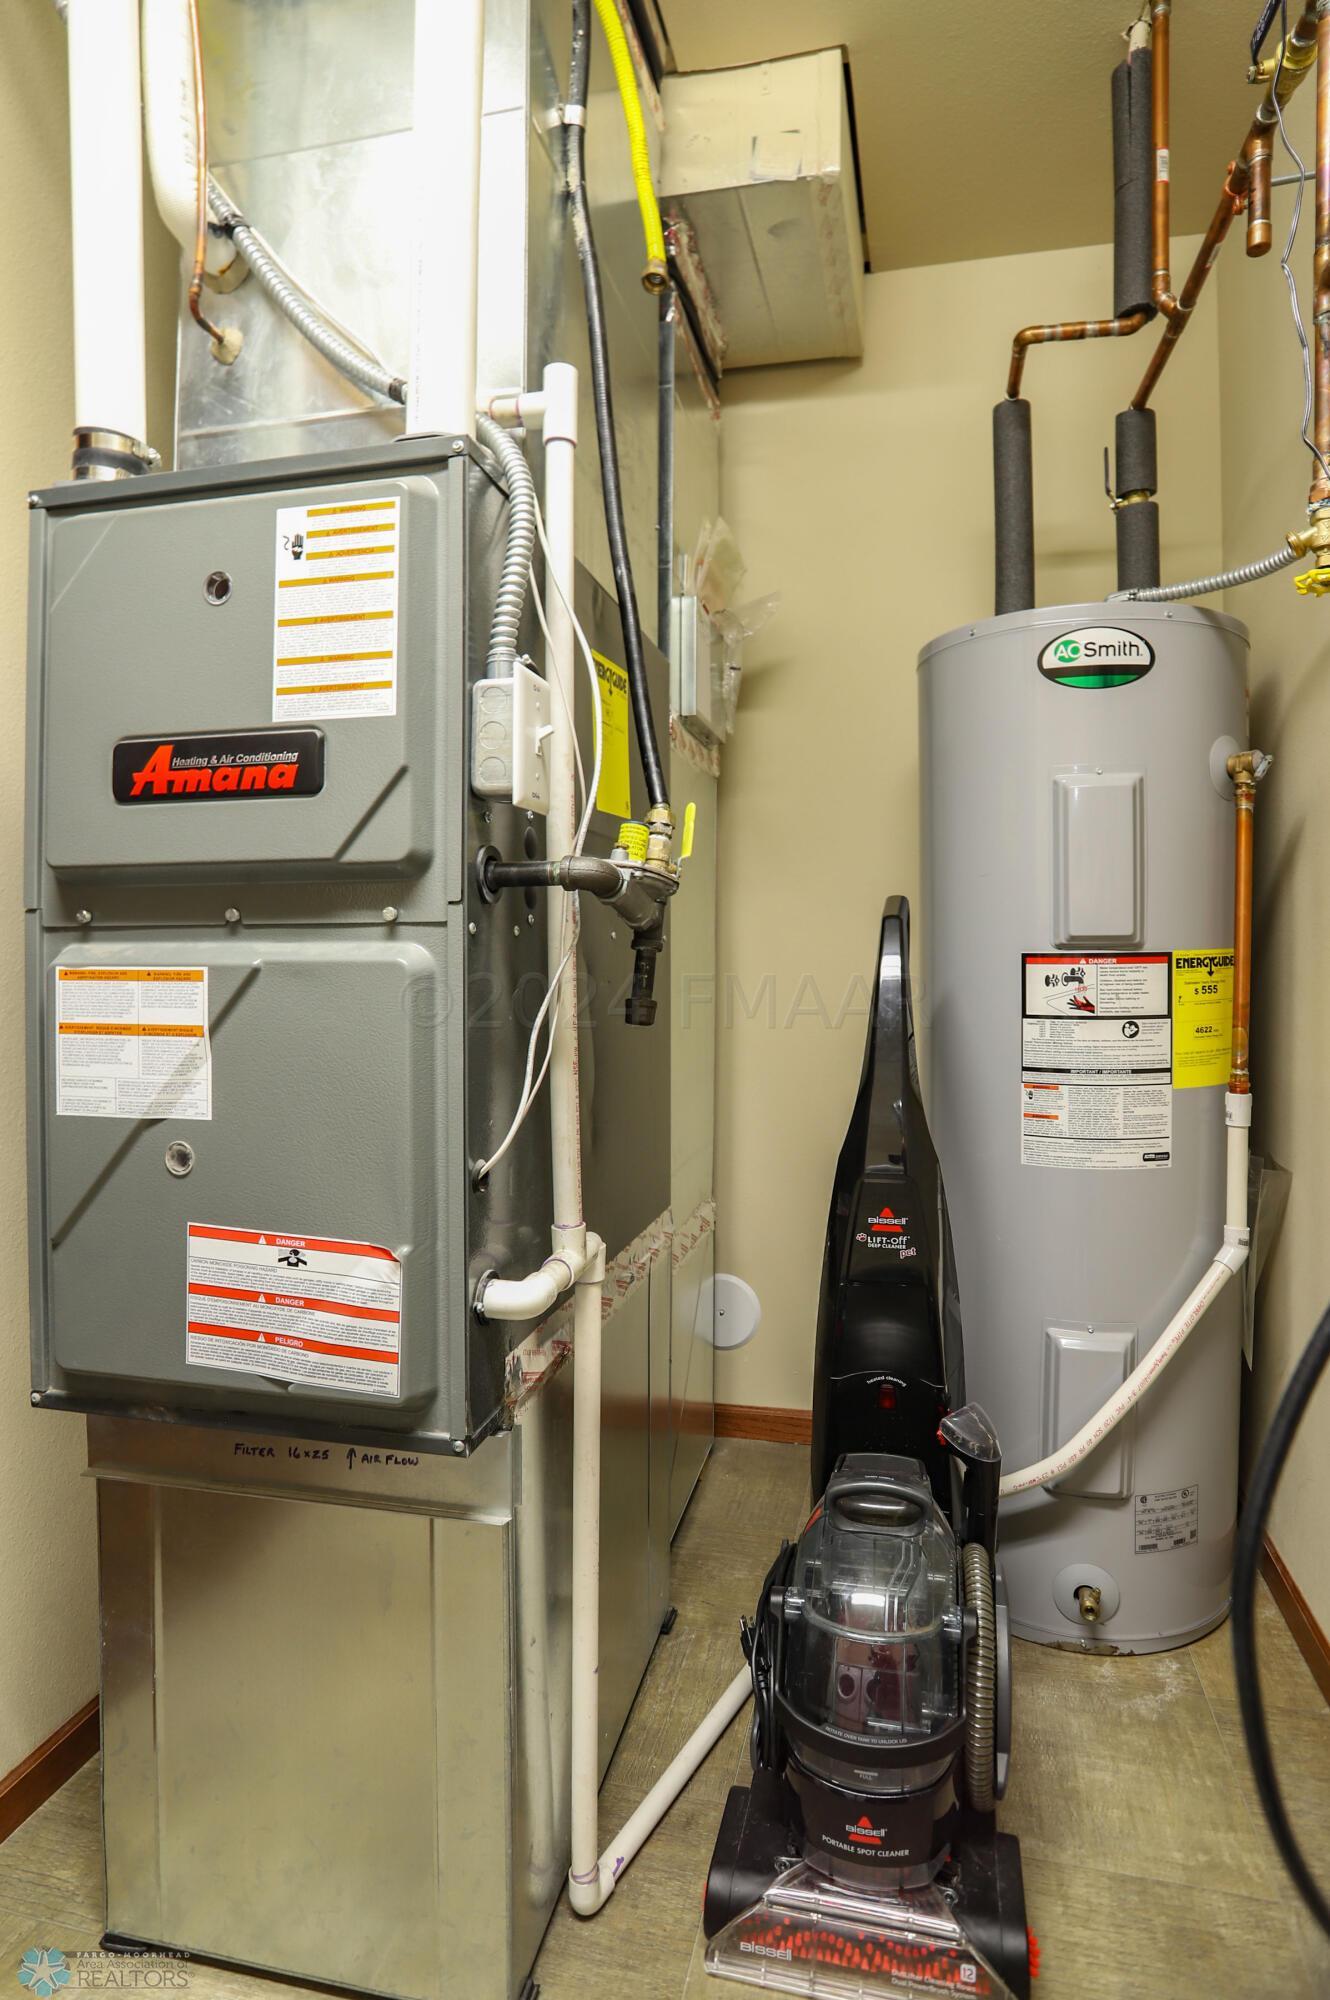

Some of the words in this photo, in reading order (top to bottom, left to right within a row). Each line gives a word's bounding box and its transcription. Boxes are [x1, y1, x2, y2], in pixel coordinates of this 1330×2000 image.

[171, 756, 208, 768] Heating
[210, 755, 218, 764] &
[219, 753, 234, 764] Air
[235, 750, 299, 763] Conditioning
[129, 744, 299, 796] Amana
[1201, 984, 1218, 995] 555
[1195, 1025, 1213, 1034] 4622
[275, 1237, 306, 1248] DANGER
[275, 1296, 305, 1308] DANGER
[275, 1335, 304, 1348] PELIGRO
[822, 1834, 856, 1853] PORTABLE
[856, 1847, 876, 1857] SPOT
[877, 1849, 910, 1858] CLEANER
[962, 1967, 975, 1980] 12
